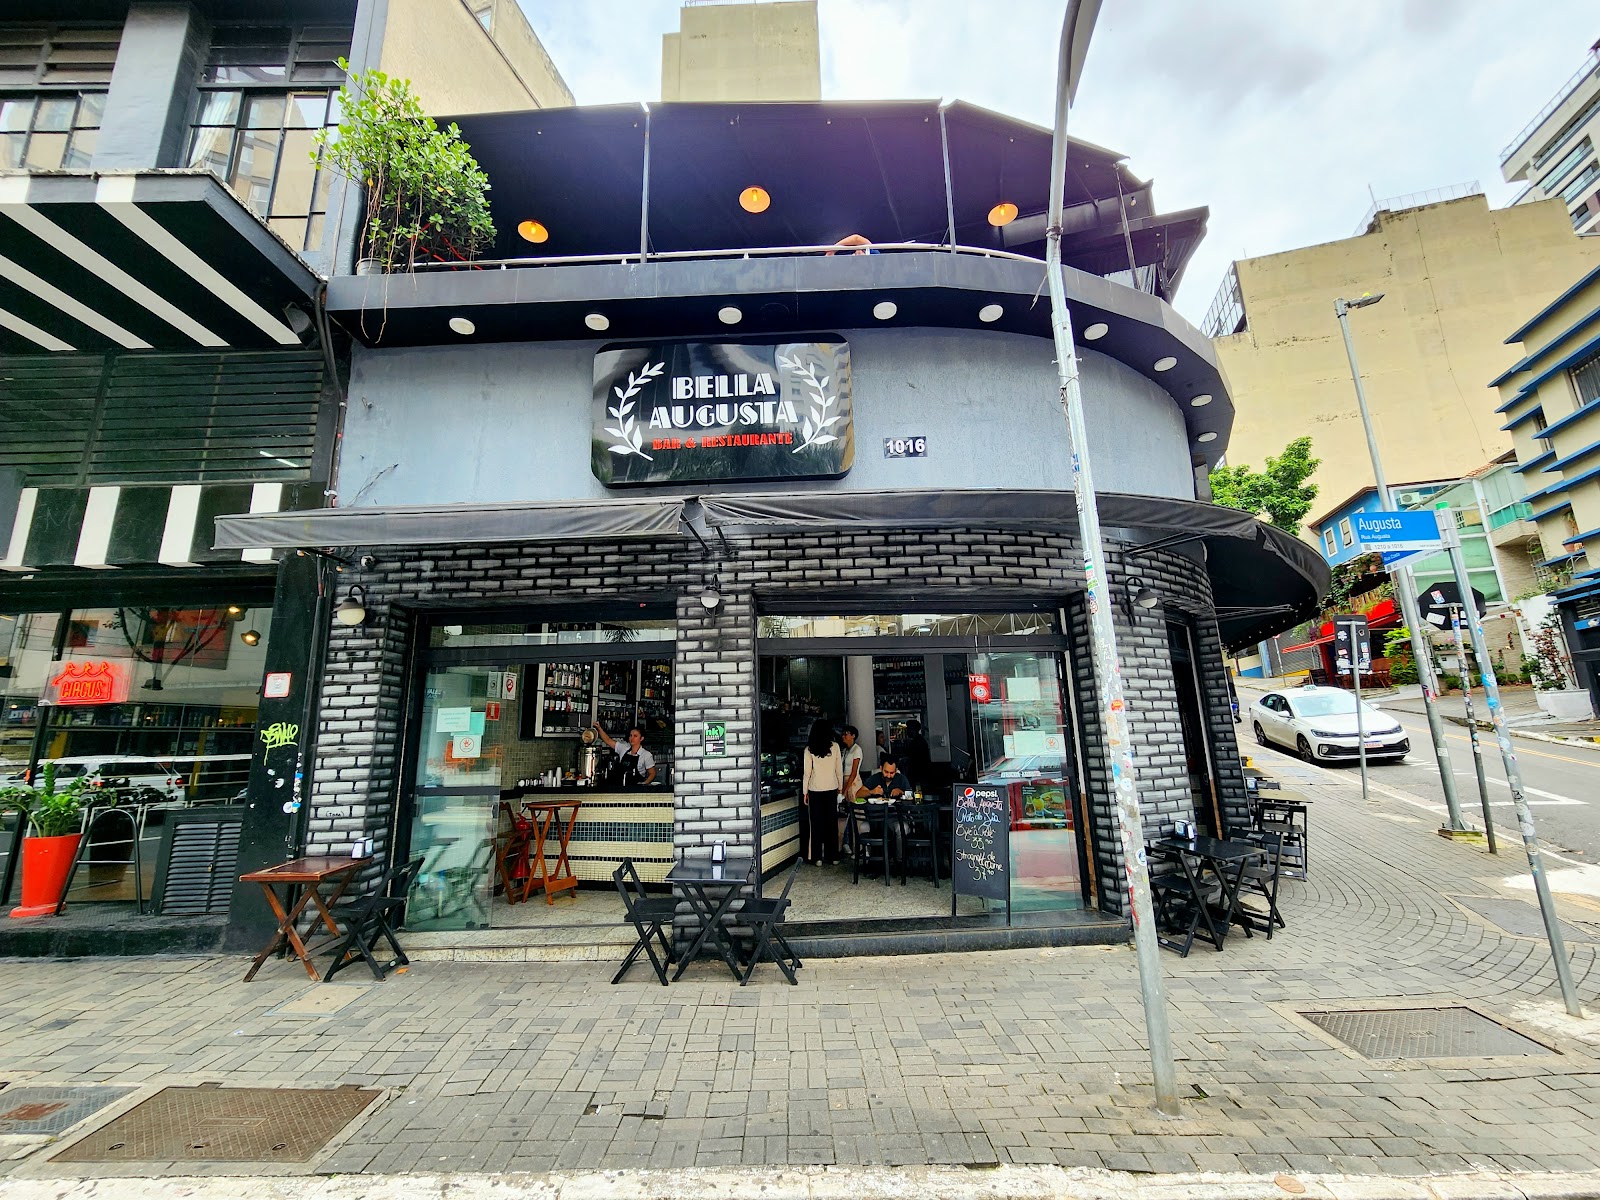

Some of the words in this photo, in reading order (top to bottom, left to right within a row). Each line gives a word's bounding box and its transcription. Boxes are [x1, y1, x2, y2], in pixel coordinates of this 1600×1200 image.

[672, 373, 776, 400] BELLA
[648, 401, 799, 430] AUGUSTA
[652, 437, 681, 450] BAR
[684, 436, 697, 449] &
[701, 432, 793, 449] RESTAURANTE
[886, 438, 926, 455] 1016
[1359, 517, 1402, 532] Augusta
[61, 680, 105, 698] CIRCUS
[956, 795, 977, 808] Bella
[975, 790, 998, 798] pepsi
